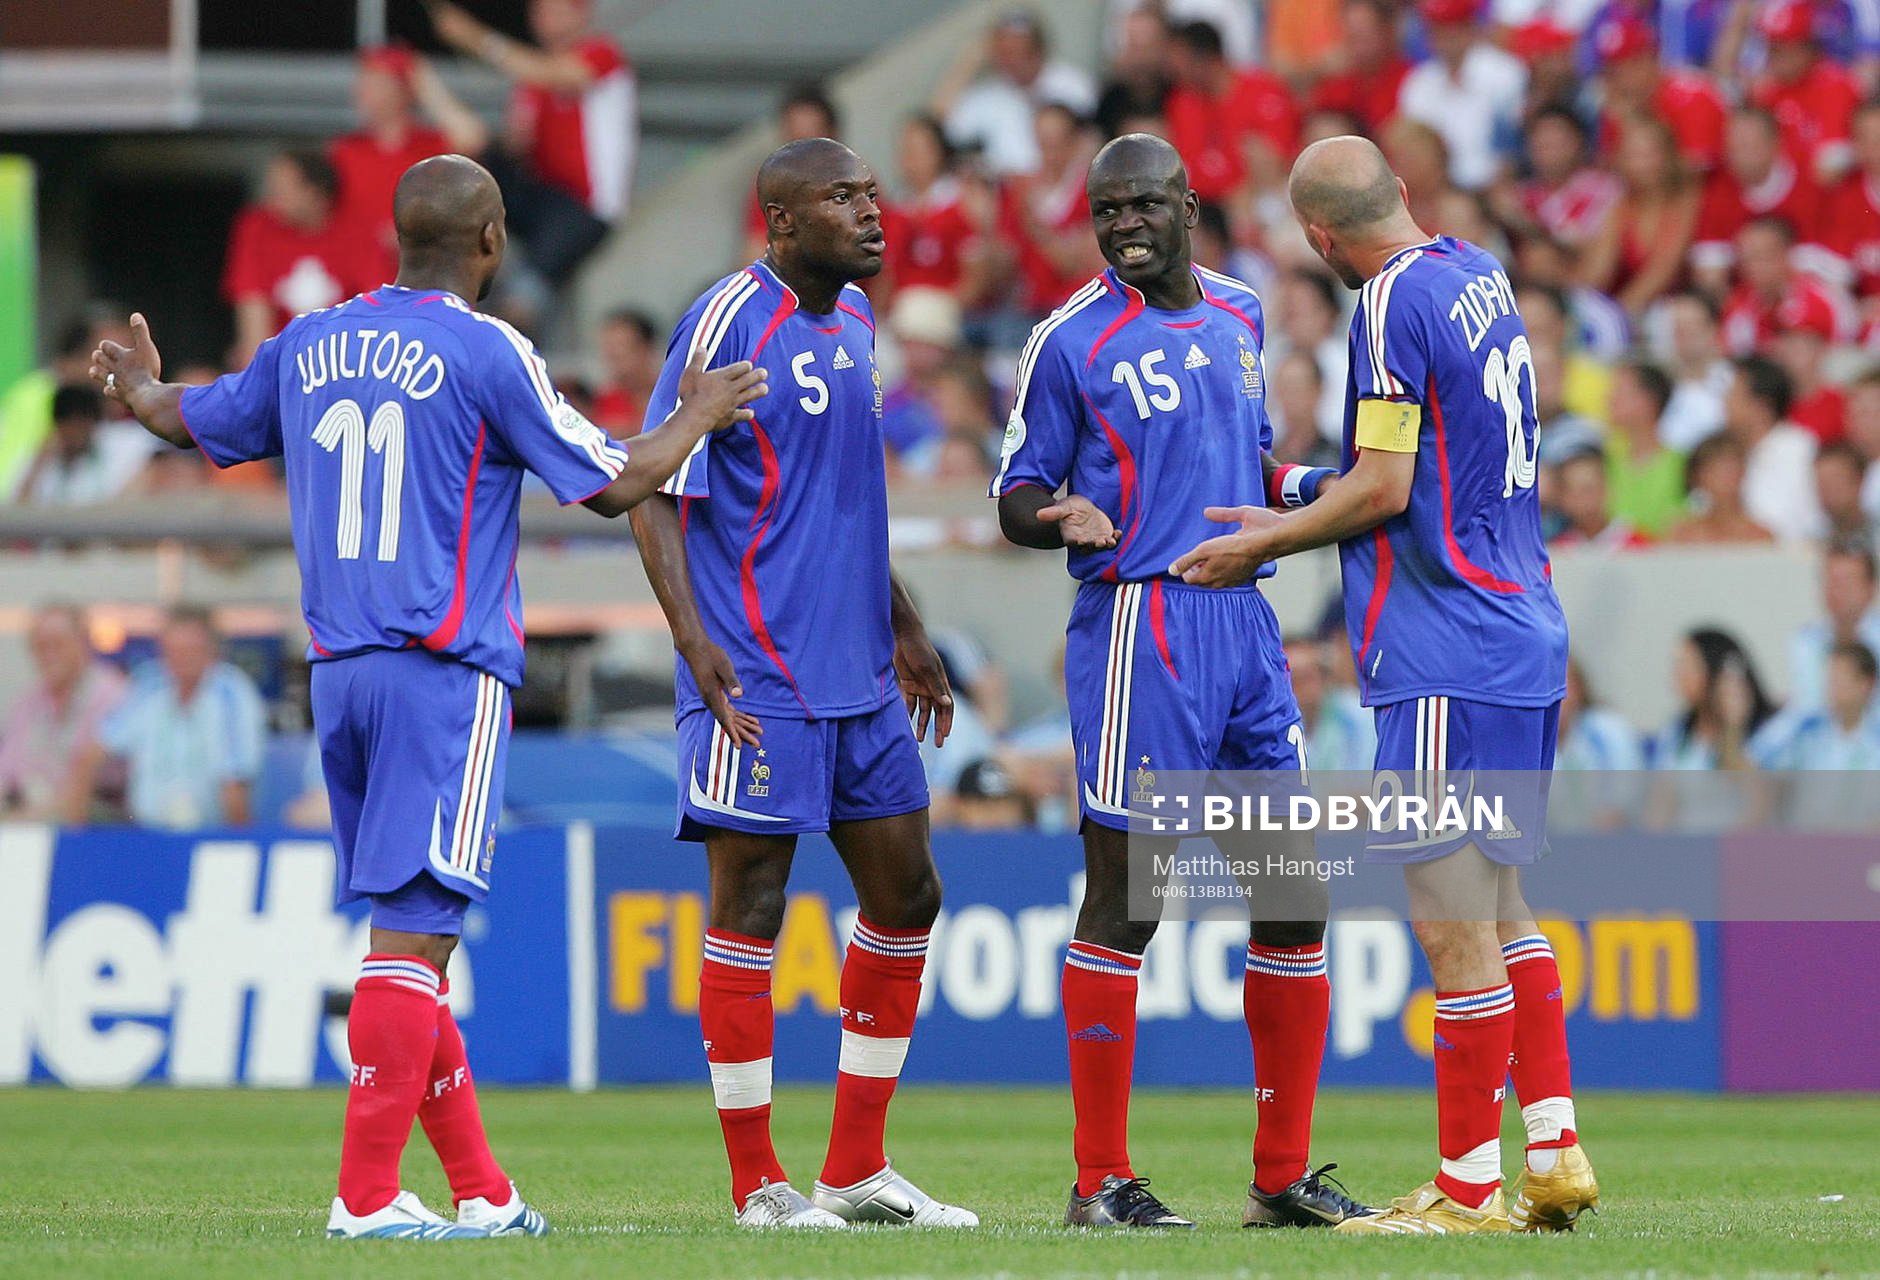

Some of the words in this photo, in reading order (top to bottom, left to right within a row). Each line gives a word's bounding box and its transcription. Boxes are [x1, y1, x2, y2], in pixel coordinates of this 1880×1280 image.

[296, 329, 446, 401] WILTORD
[790, 350, 829, 416] 5
[1111, 348, 1182, 421] 15
[1483, 335, 1541, 498] 10
[311, 398, 406, 562] 11
[1486, 830, 1522, 841] adidas
[0, 822, 475, 1090] lett
[607, 872, 1699, 1060] FIAordcp.m
